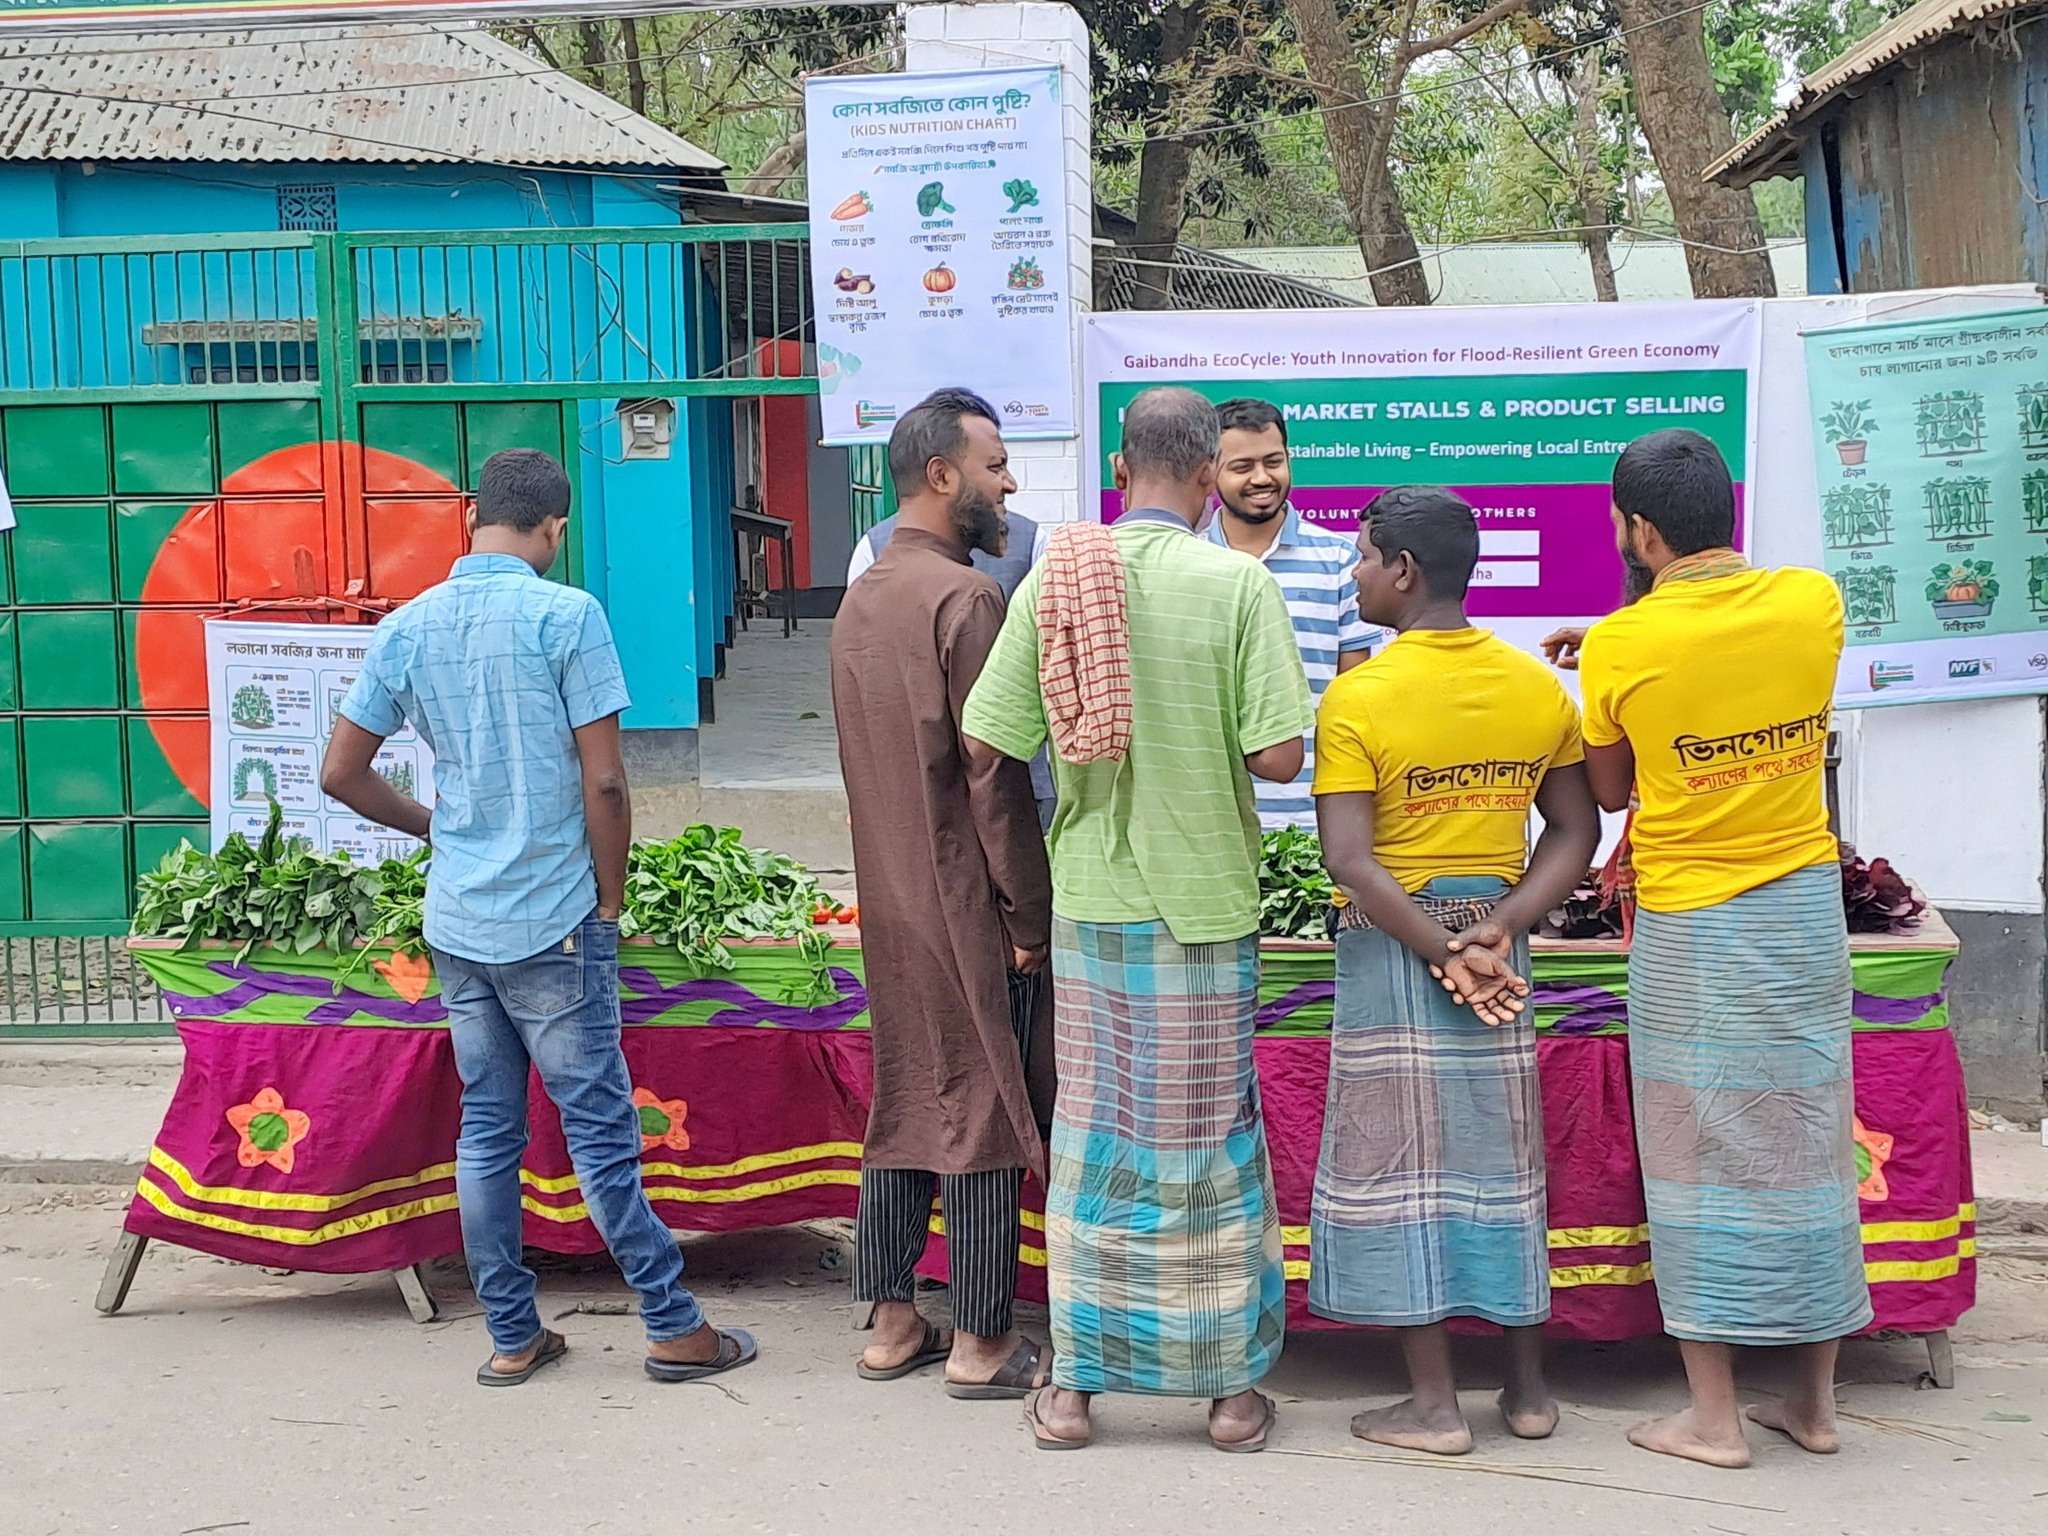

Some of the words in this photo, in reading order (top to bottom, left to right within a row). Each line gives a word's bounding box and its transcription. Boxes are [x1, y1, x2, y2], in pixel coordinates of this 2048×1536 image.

[833, 102, 872, 118] কোন
[874, 96, 945, 116] সবজিতে
[949, 96, 989, 112] কোন
[992, 88, 1031, 115] পুষ্টি?
[851, 124, 887, 138] (KIDS
[890, 119, 963, 135] NUTRITION
[967, 116, 1017, 130] CHART)
[1124, 353, 1208, 369] Gaibandha
[1213, 351, 1286, 370] EcoCycle:
[1290, 351, 1336, 366] Youth
[1341, 349, 1428, 365] Innovation
[1433, 348, 1455, 363] for
[1460, 345, 1584, 362] Flood-Resilient
[1588, 344, 1638, 359] Green
[1644, 343, 1720, 360] Economy
[1282, 402, 1377, 421] MARKET
[1386, 401, 1470, 419] STALLS
[1479, 401, 1496, 418] &
[1505, 398, 1617, 417] PRODUCT
[1625, 395, 1725, 414] SELLING
[1288, 441, 1361, 459] stainable
[1364, 442, 1412, 460] Living
[1429, 440, 1533, 459] Empowering
[1537, 439, 1579, 455] Local
[1584, 439, 1632, 455] Entre
[1296, 508, 1361, 519] VOLUNT
[1471, 507, 1537, 518] OTHERS
[226, 643, 268, 656] লতানো
[271, 642, 314, 659] সবজির
[316, 646, 343, 660] জন্য
[1950, 661, 1978, 674] NYF
[1684, 766, 1748, 791] কল্যাণের
[1753, 758, 1785, 778] পথে
[1403, 796, 1461, 817] কল্যাণের
[1464, 793, 1494, 809] পথে
